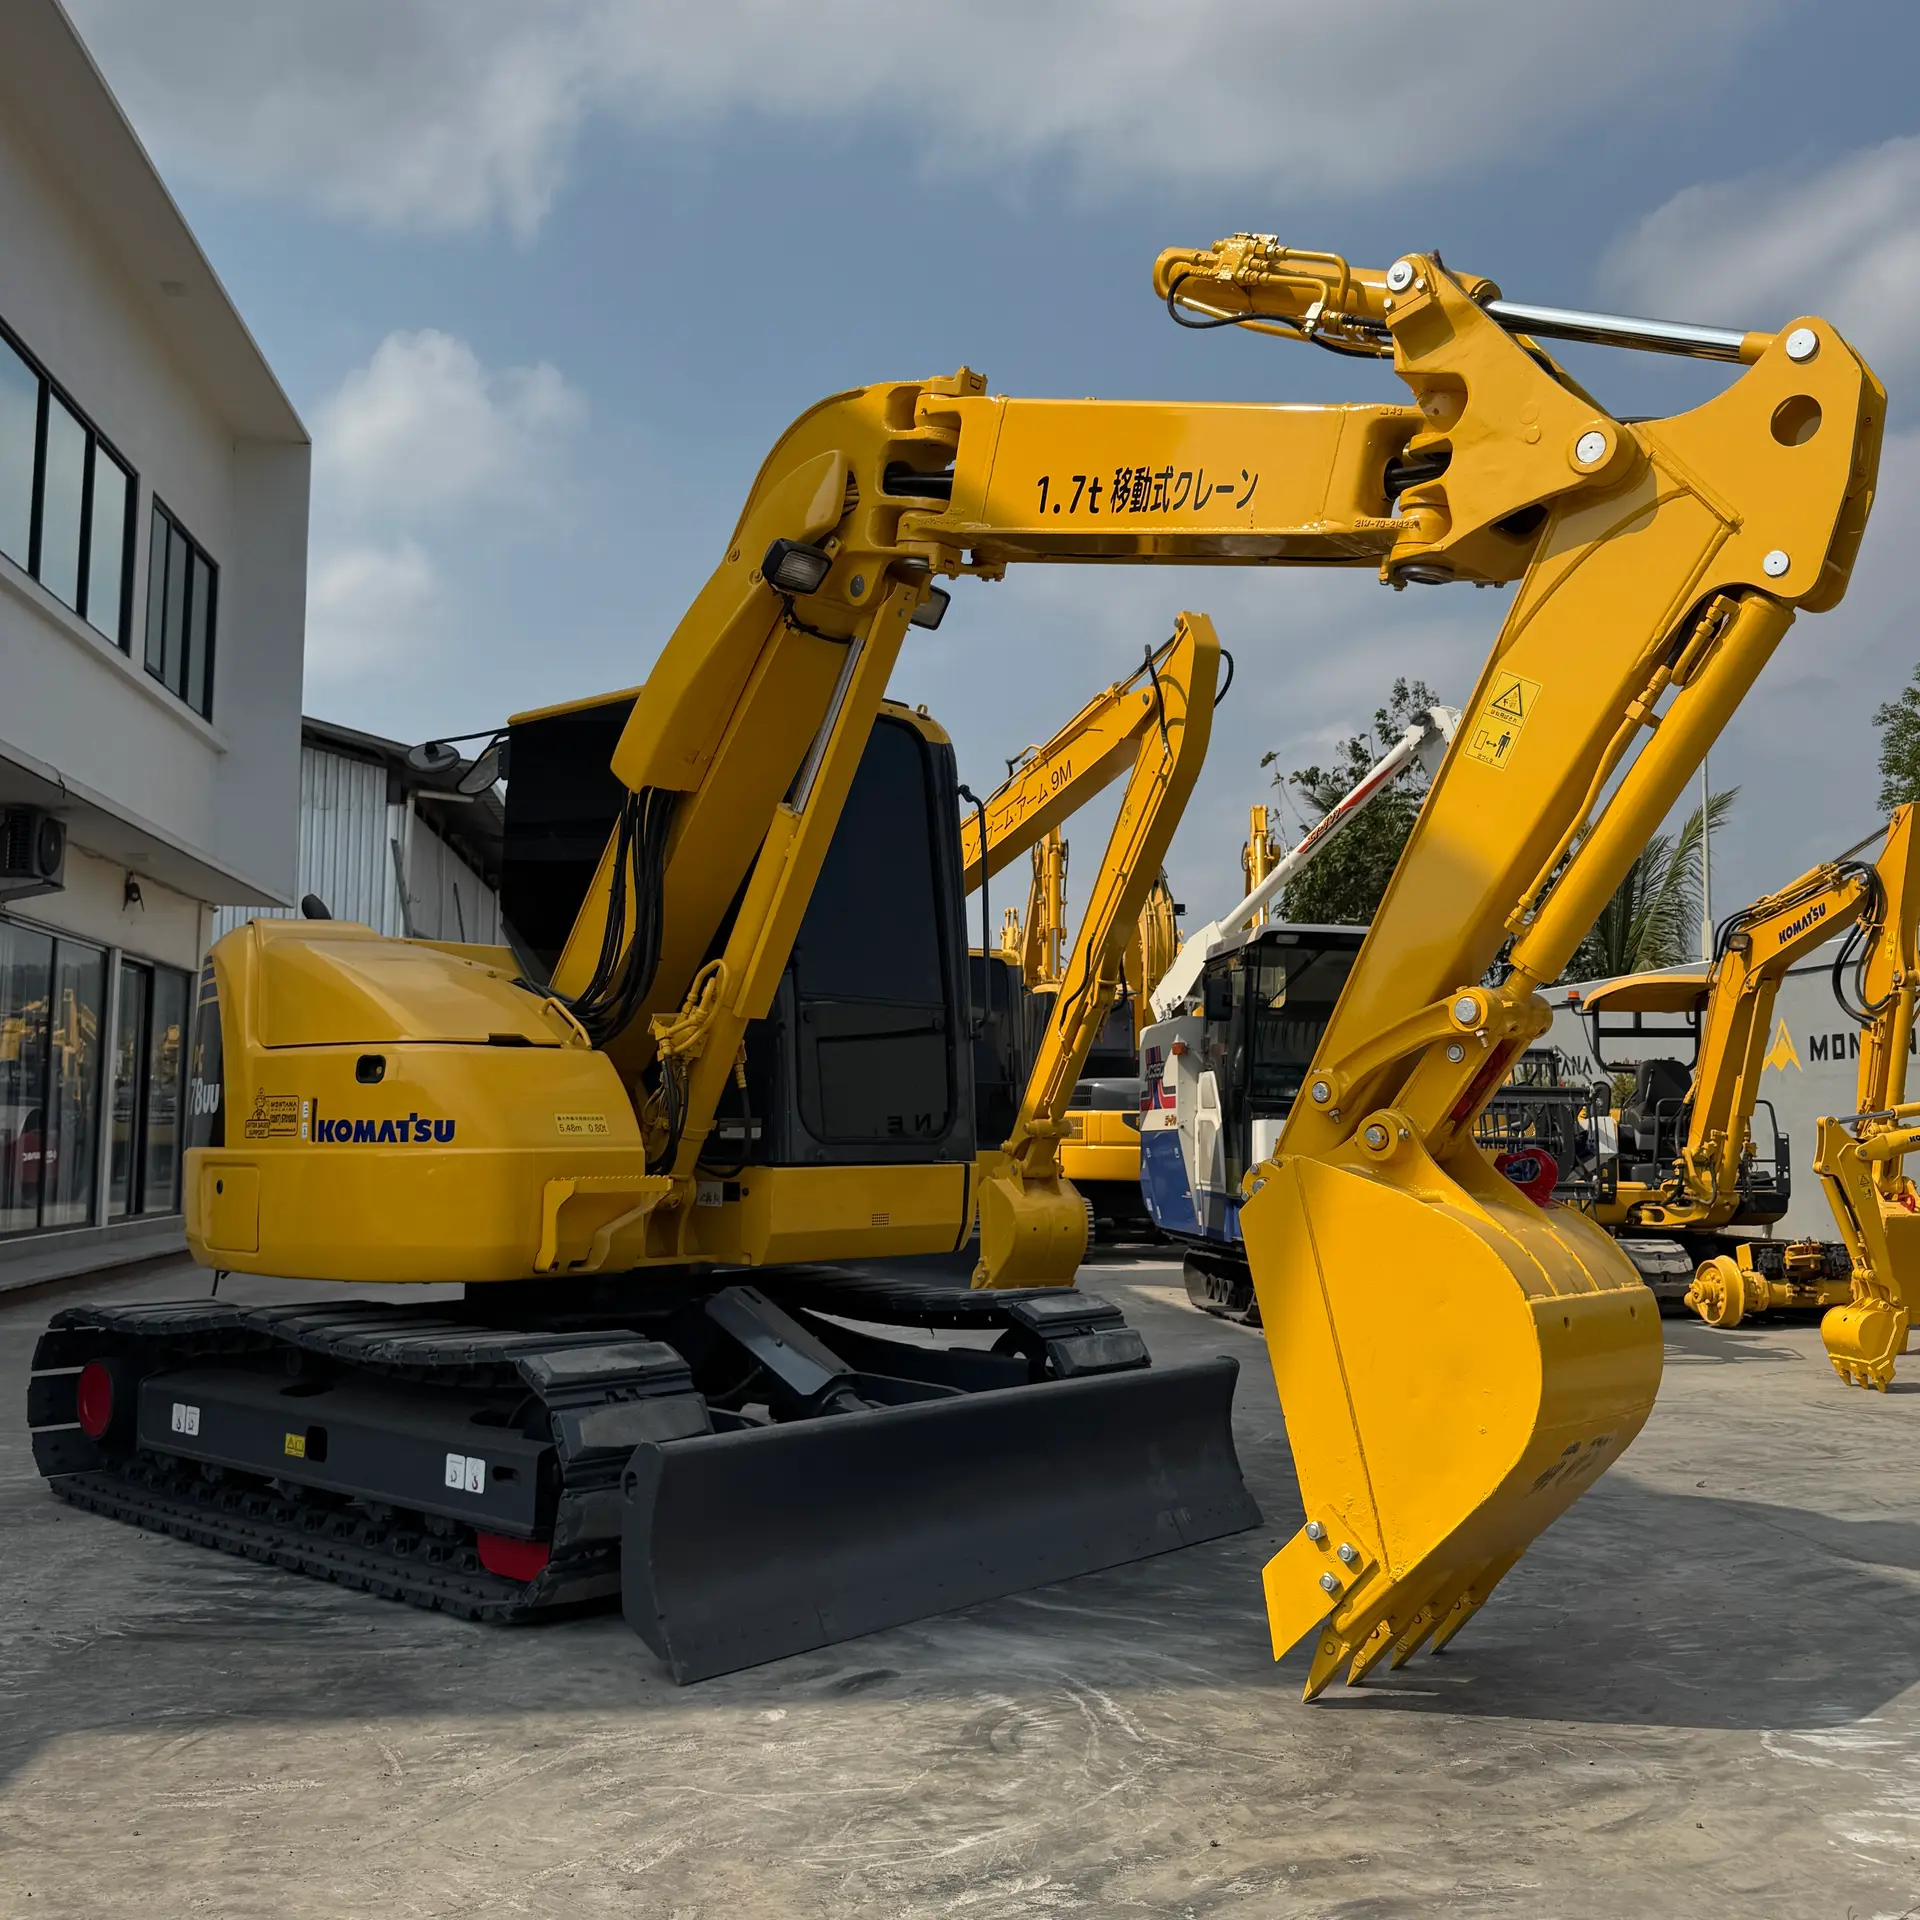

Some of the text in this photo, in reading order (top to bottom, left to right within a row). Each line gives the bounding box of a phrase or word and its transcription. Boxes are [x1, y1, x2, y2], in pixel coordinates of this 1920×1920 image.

[1037, 465, 1258, 514] 1.7t 移動式クレーン
[1051, 759, 1072, 791] 9M
[1778, 902, 1826, 945] KOMATSU
[318, 1113, 456, 1143] KOMATSU
